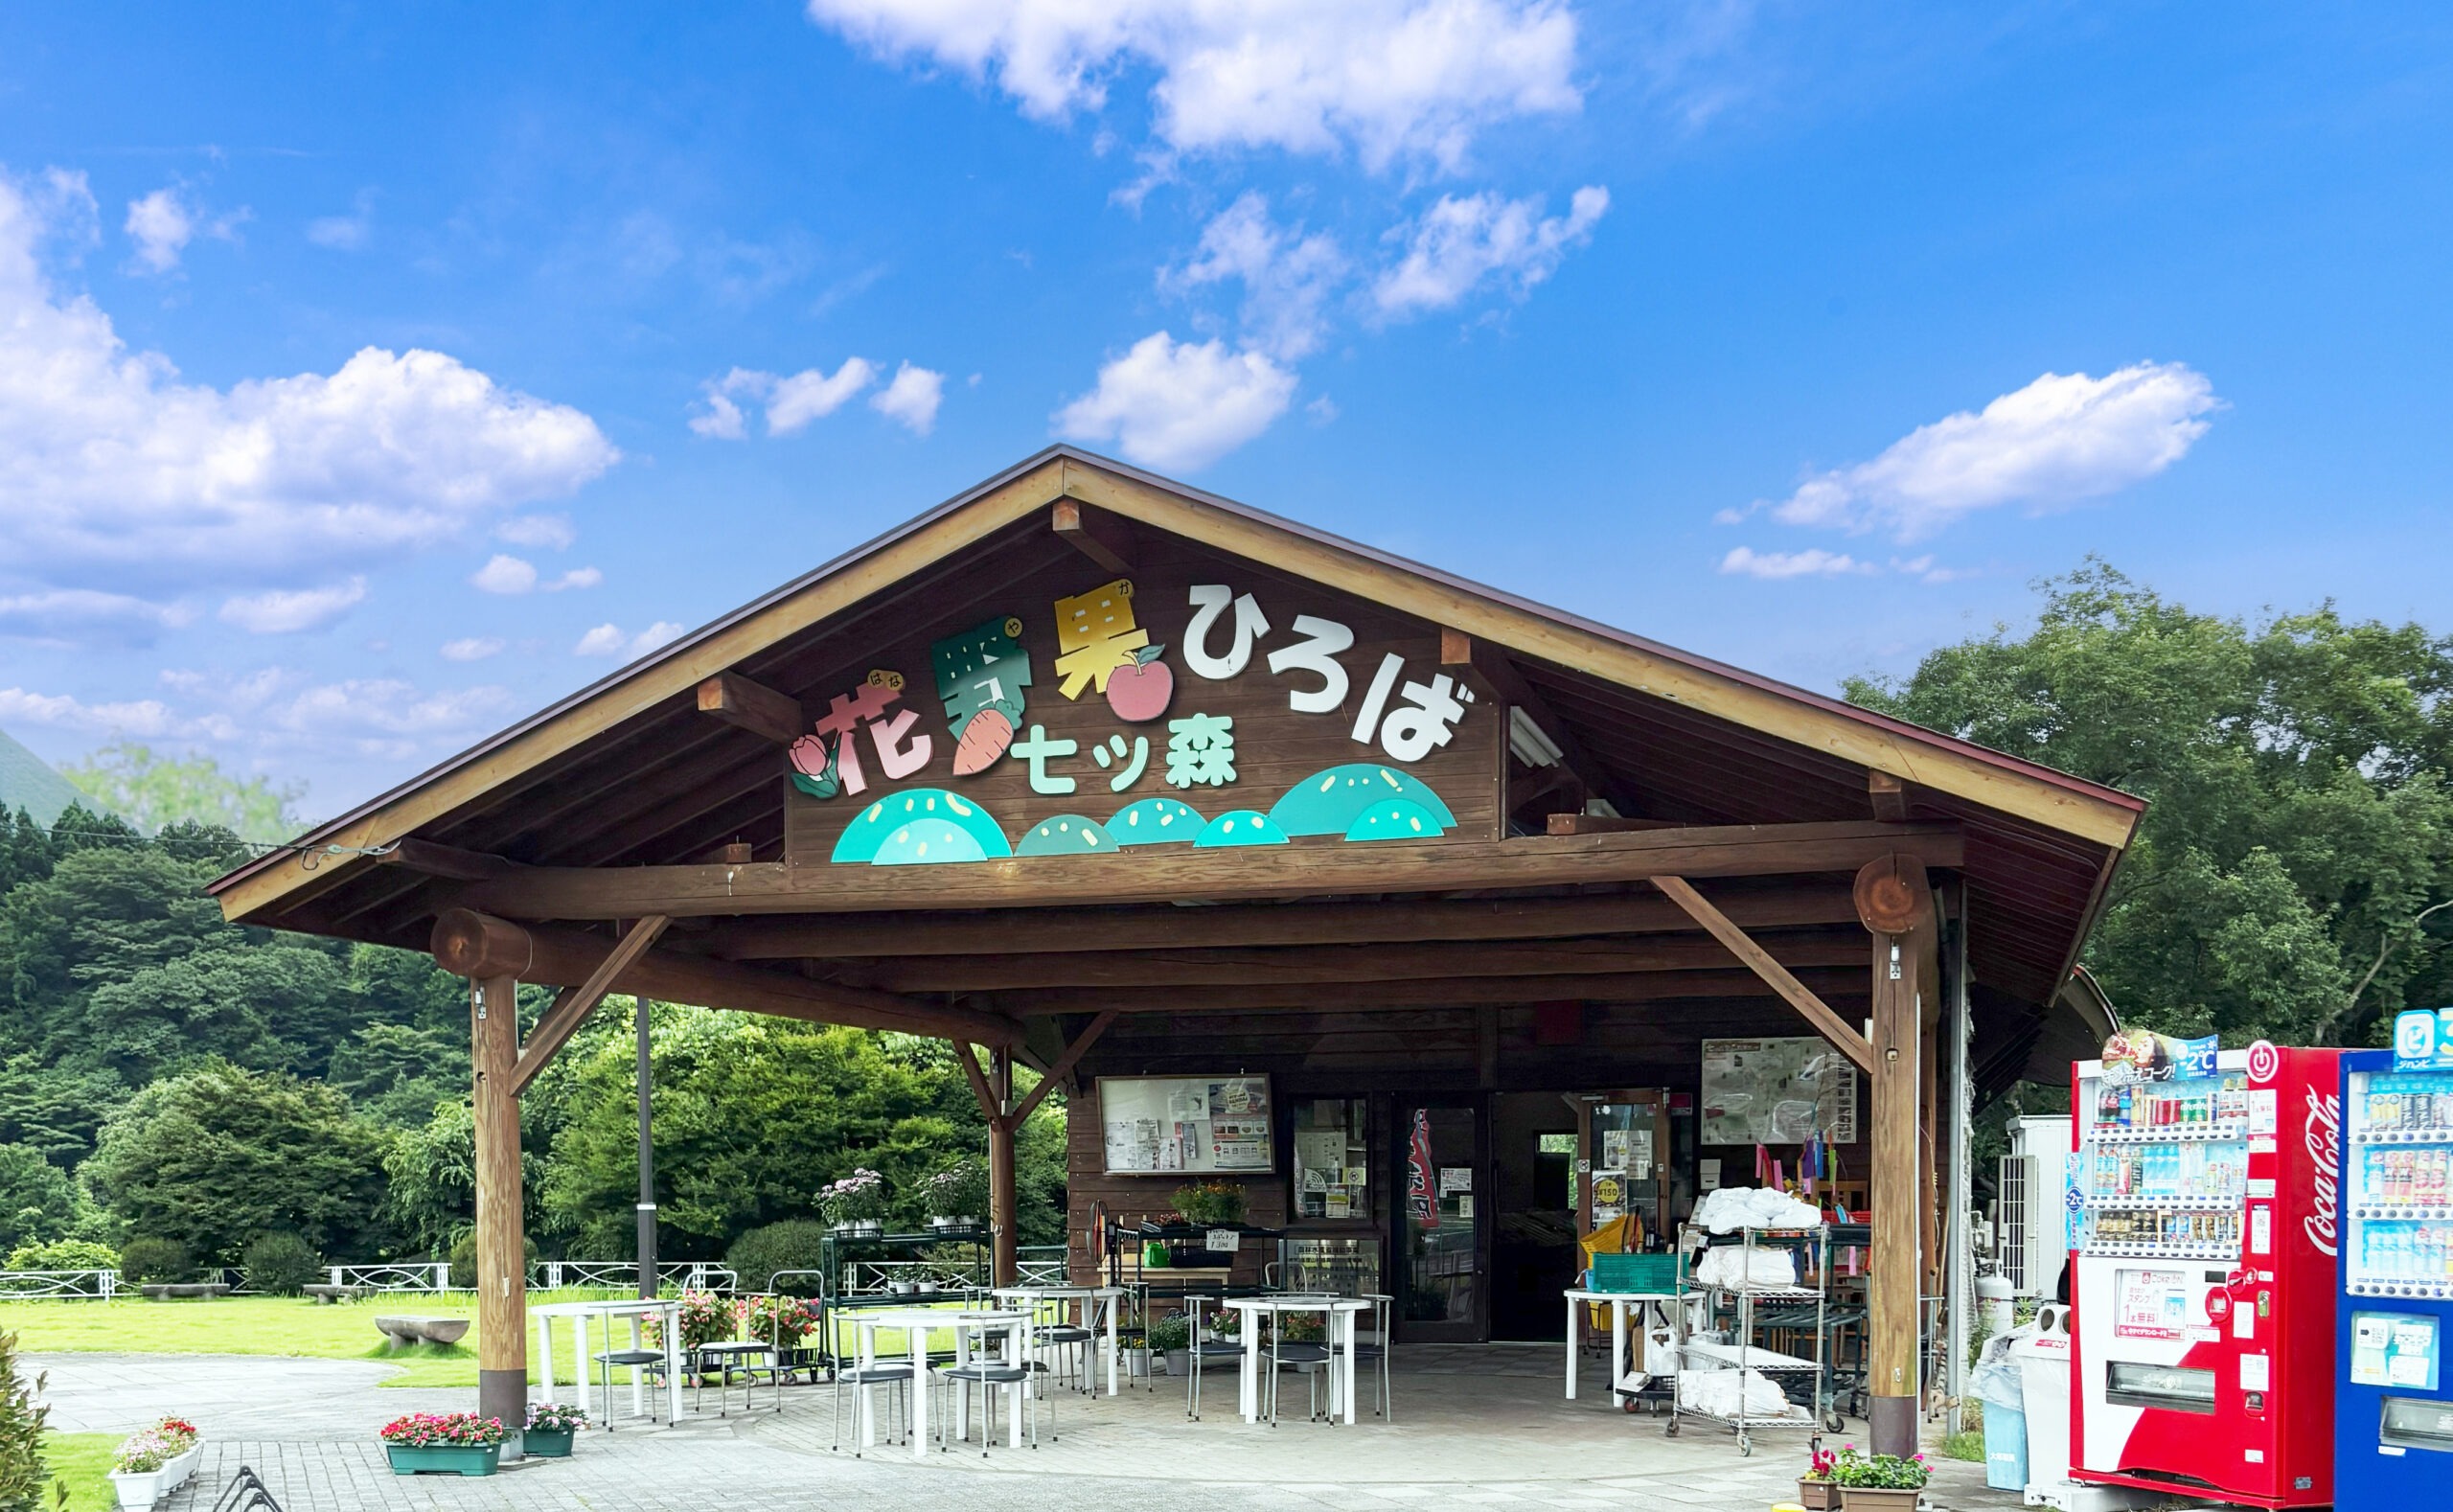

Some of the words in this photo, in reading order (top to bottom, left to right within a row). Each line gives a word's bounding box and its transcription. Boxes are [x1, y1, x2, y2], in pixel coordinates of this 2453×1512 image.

[1007, 621, 1020, 634] や
[869, 672, 903, 689] はな
[1009, 712, 1239, 795] 七ツ森
